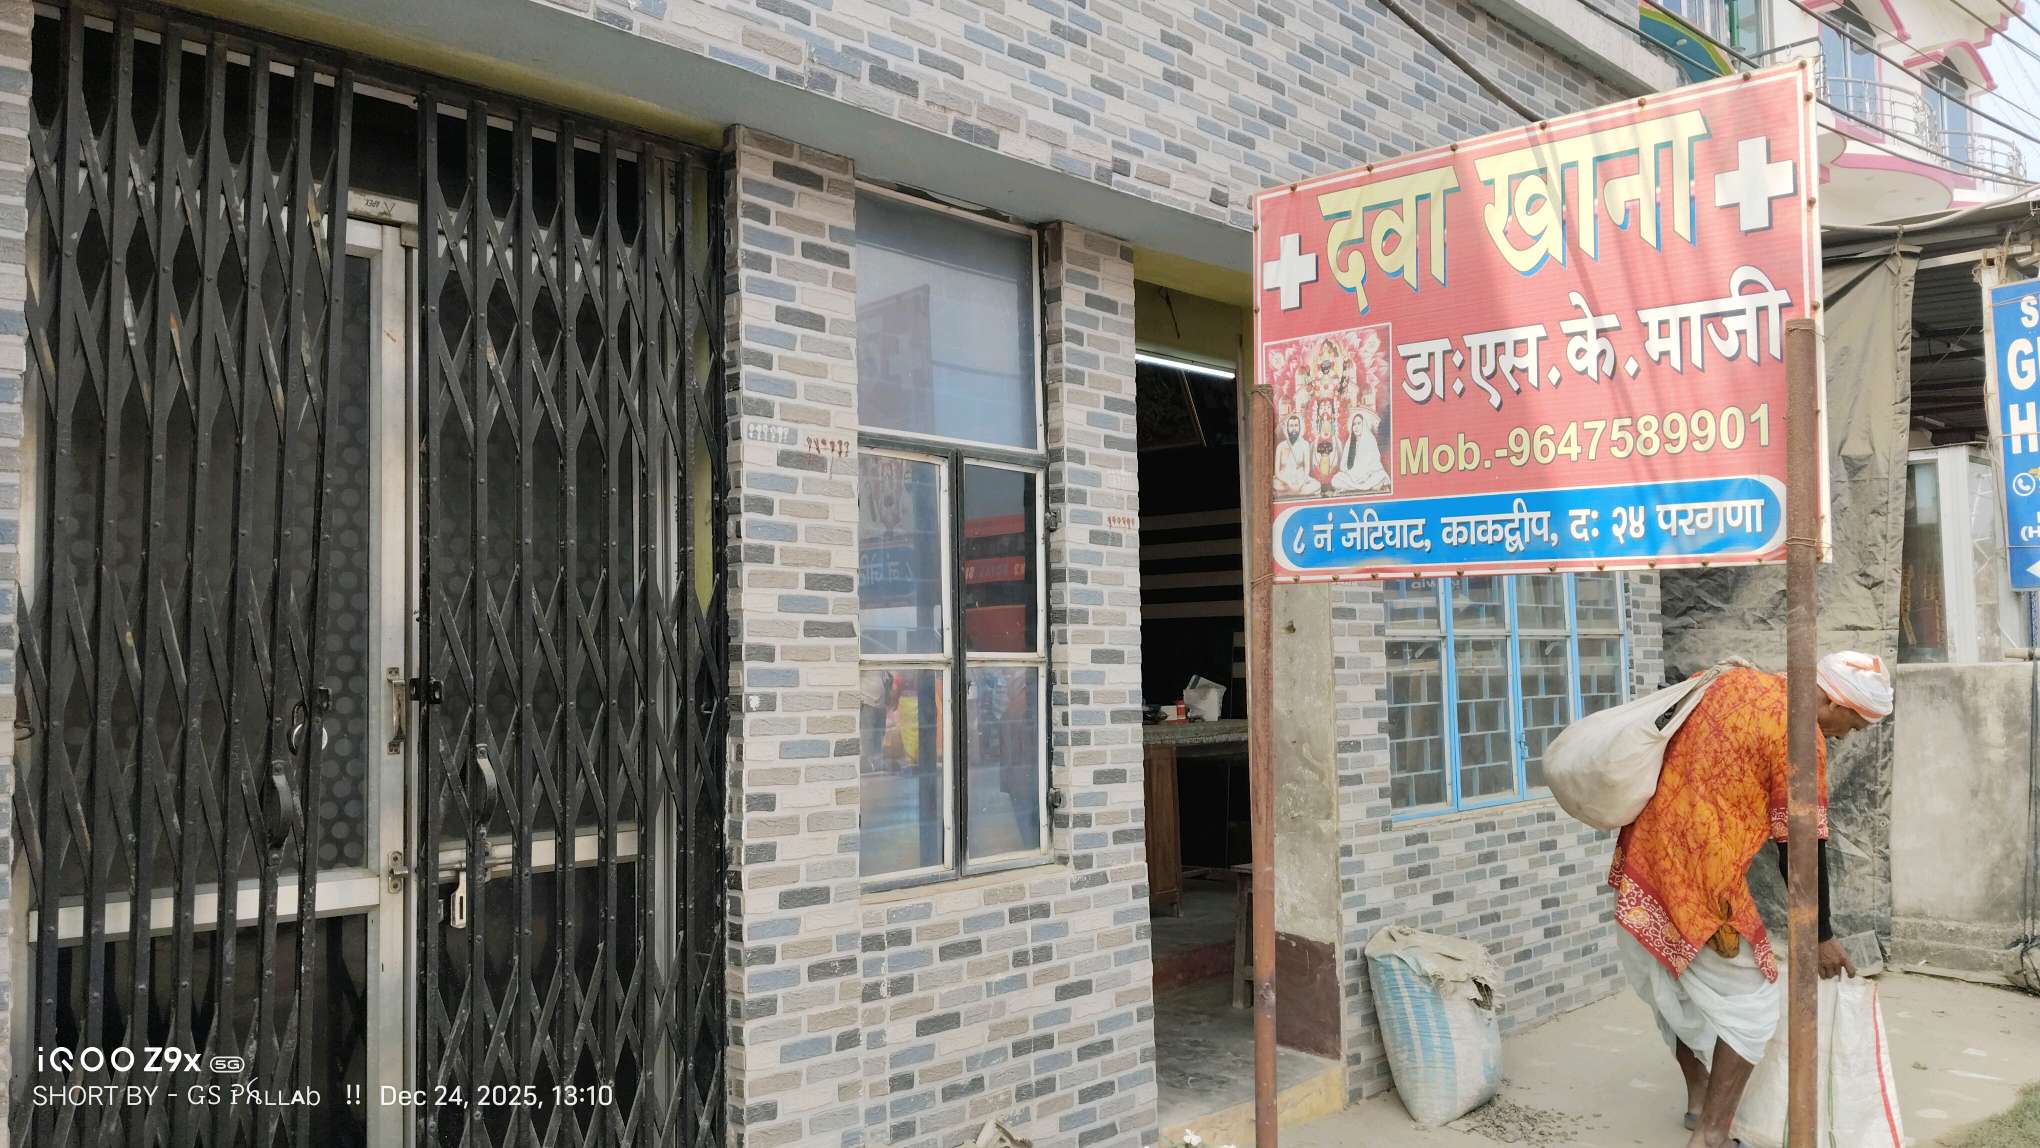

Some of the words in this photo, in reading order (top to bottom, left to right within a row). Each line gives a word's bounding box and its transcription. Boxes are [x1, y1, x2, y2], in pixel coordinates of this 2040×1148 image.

[1318, 166, 1461, 316] दवा
[1474, 109, 1712, 277] खाना
[2007, 337, 2040, 391] G
[1656, 499, 1765, 537] परगणा
